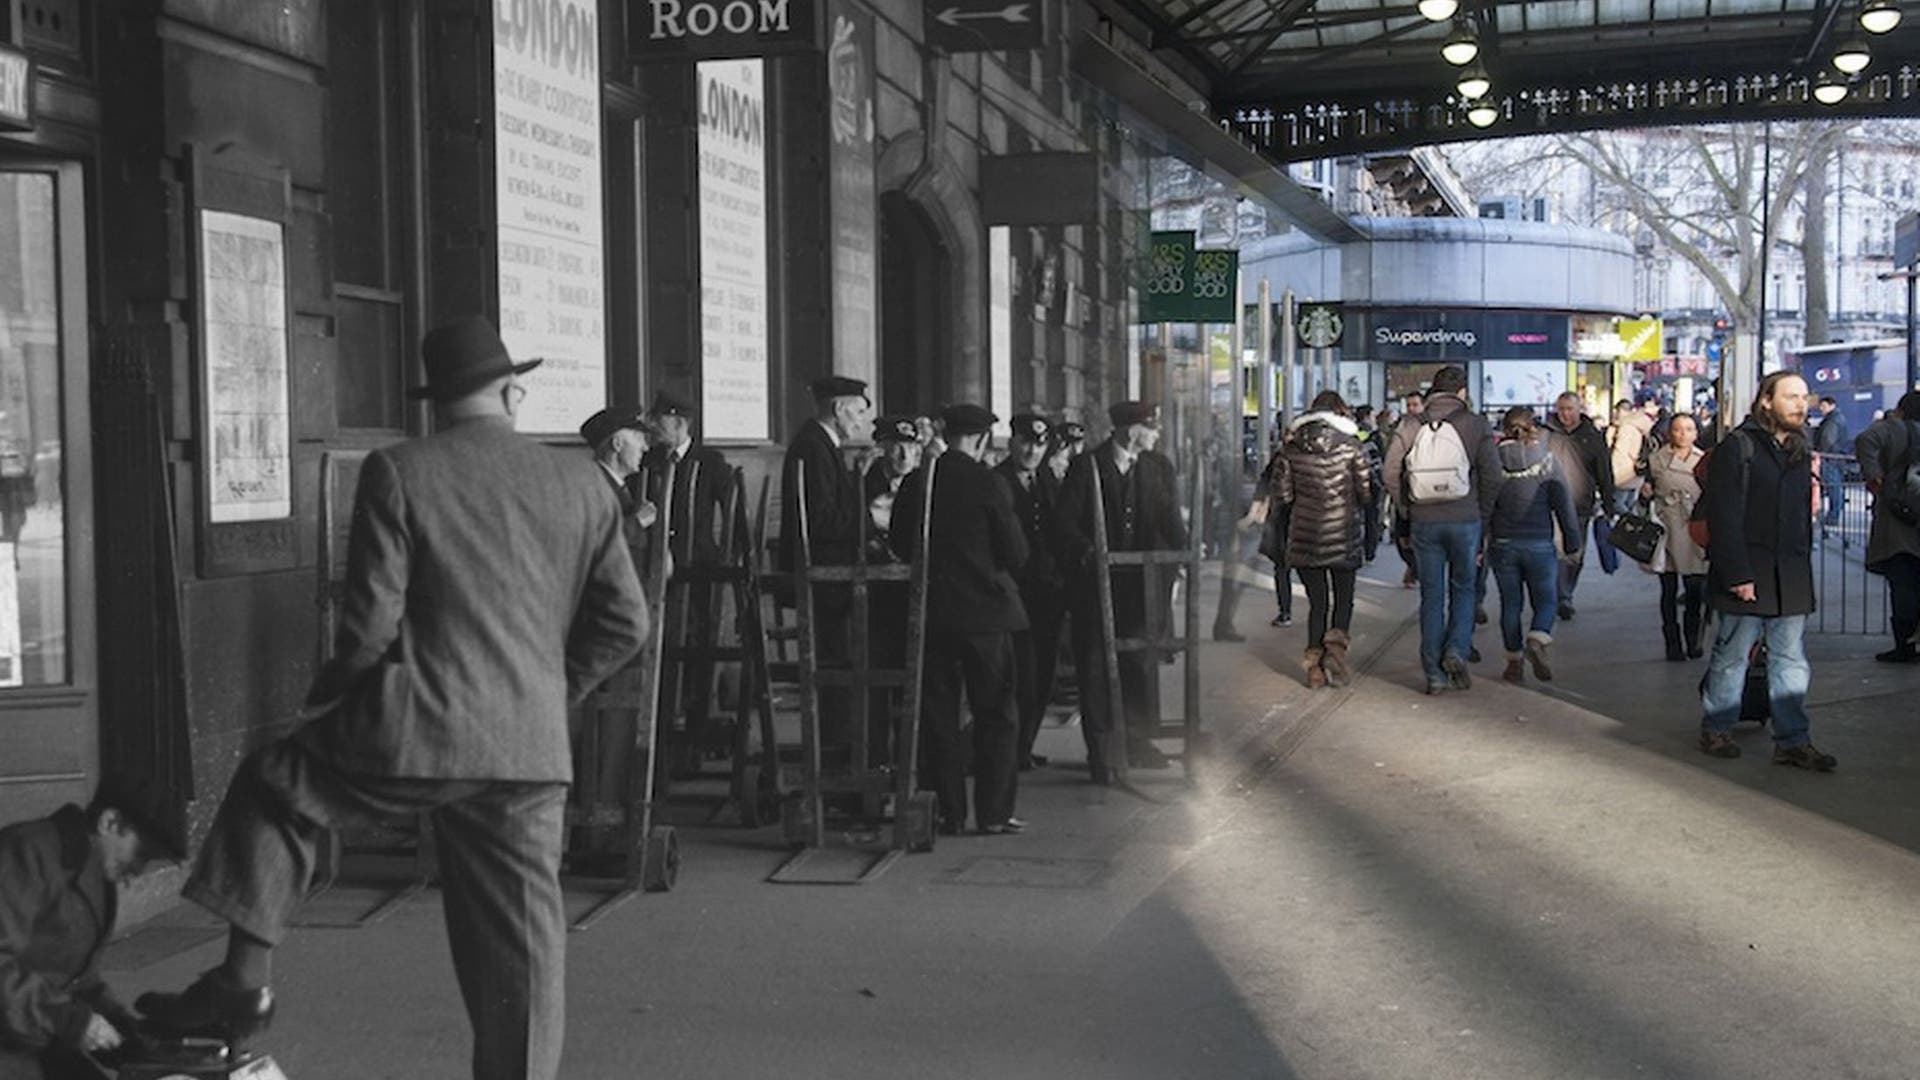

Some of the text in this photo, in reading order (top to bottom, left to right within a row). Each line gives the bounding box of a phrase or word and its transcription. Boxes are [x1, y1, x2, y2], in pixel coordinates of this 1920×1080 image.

[650, 0, 790, 39] ROOM
[495, 0, 595, 80] LONDON
[697, 71, 762, 148] LONDON
[1147, 277, 1185, 294] OOD
[1193, 282, 1228, 298] OOD
[1375, 327, 1477, 347] Superdrug
